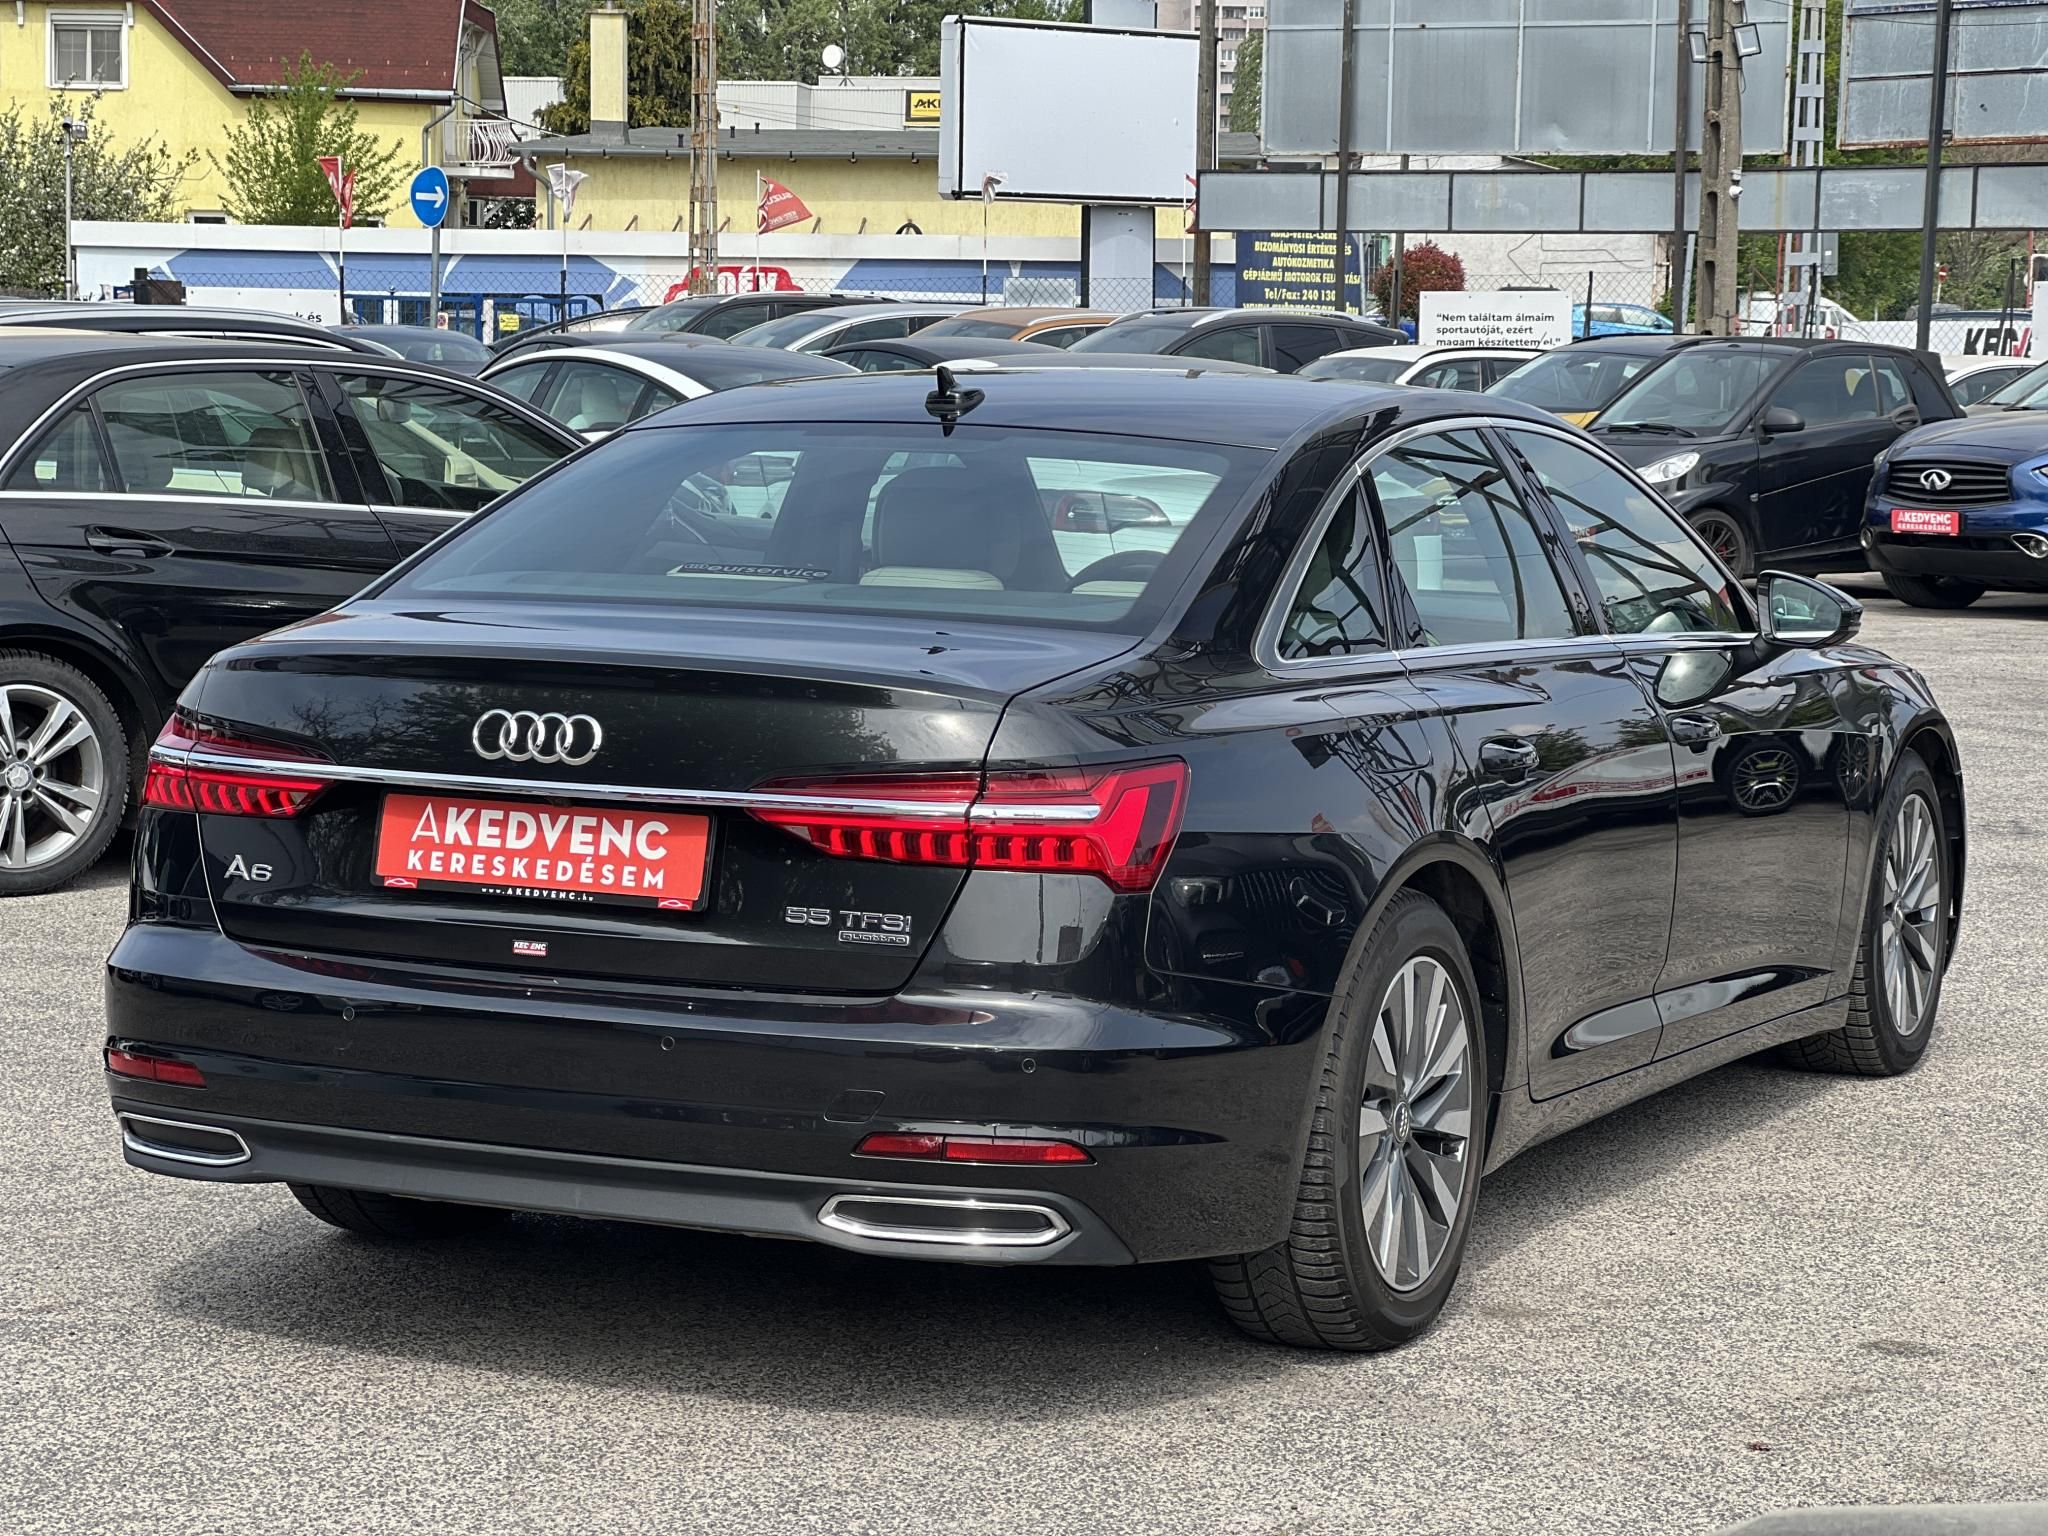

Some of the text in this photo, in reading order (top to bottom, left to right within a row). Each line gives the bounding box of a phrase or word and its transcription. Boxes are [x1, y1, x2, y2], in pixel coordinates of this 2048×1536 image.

[1254, 241, 1306, 254] BIZOMÁNYOSI
[1272, 255, 1335, 269] AUTÓKOZMETIKA
[1284, 271, 1322, 283] MOTOROK
[1264, 288, 1300, 301] Tel/Fax:
[1302, 289, 1319, 301] 240
[1468, 313, 1513, 322] találtam
[1515, 312, 1555, 322] álmaim
[1436, 326, 1534, 336] sportautóját, ezért
[1436, 338, 1475, 347] magam
[1478, 337, 1540, 347] készítettem
[1898, 511, 1952, 525] AKEDVENC
[411, 802, 669, 861] AKEDVENC
[223, 853, 273, 882] A6
[407, 849, 665, 890] KERESKEDÉSEM
[785, 906, 912, 933] 55 TFSI
